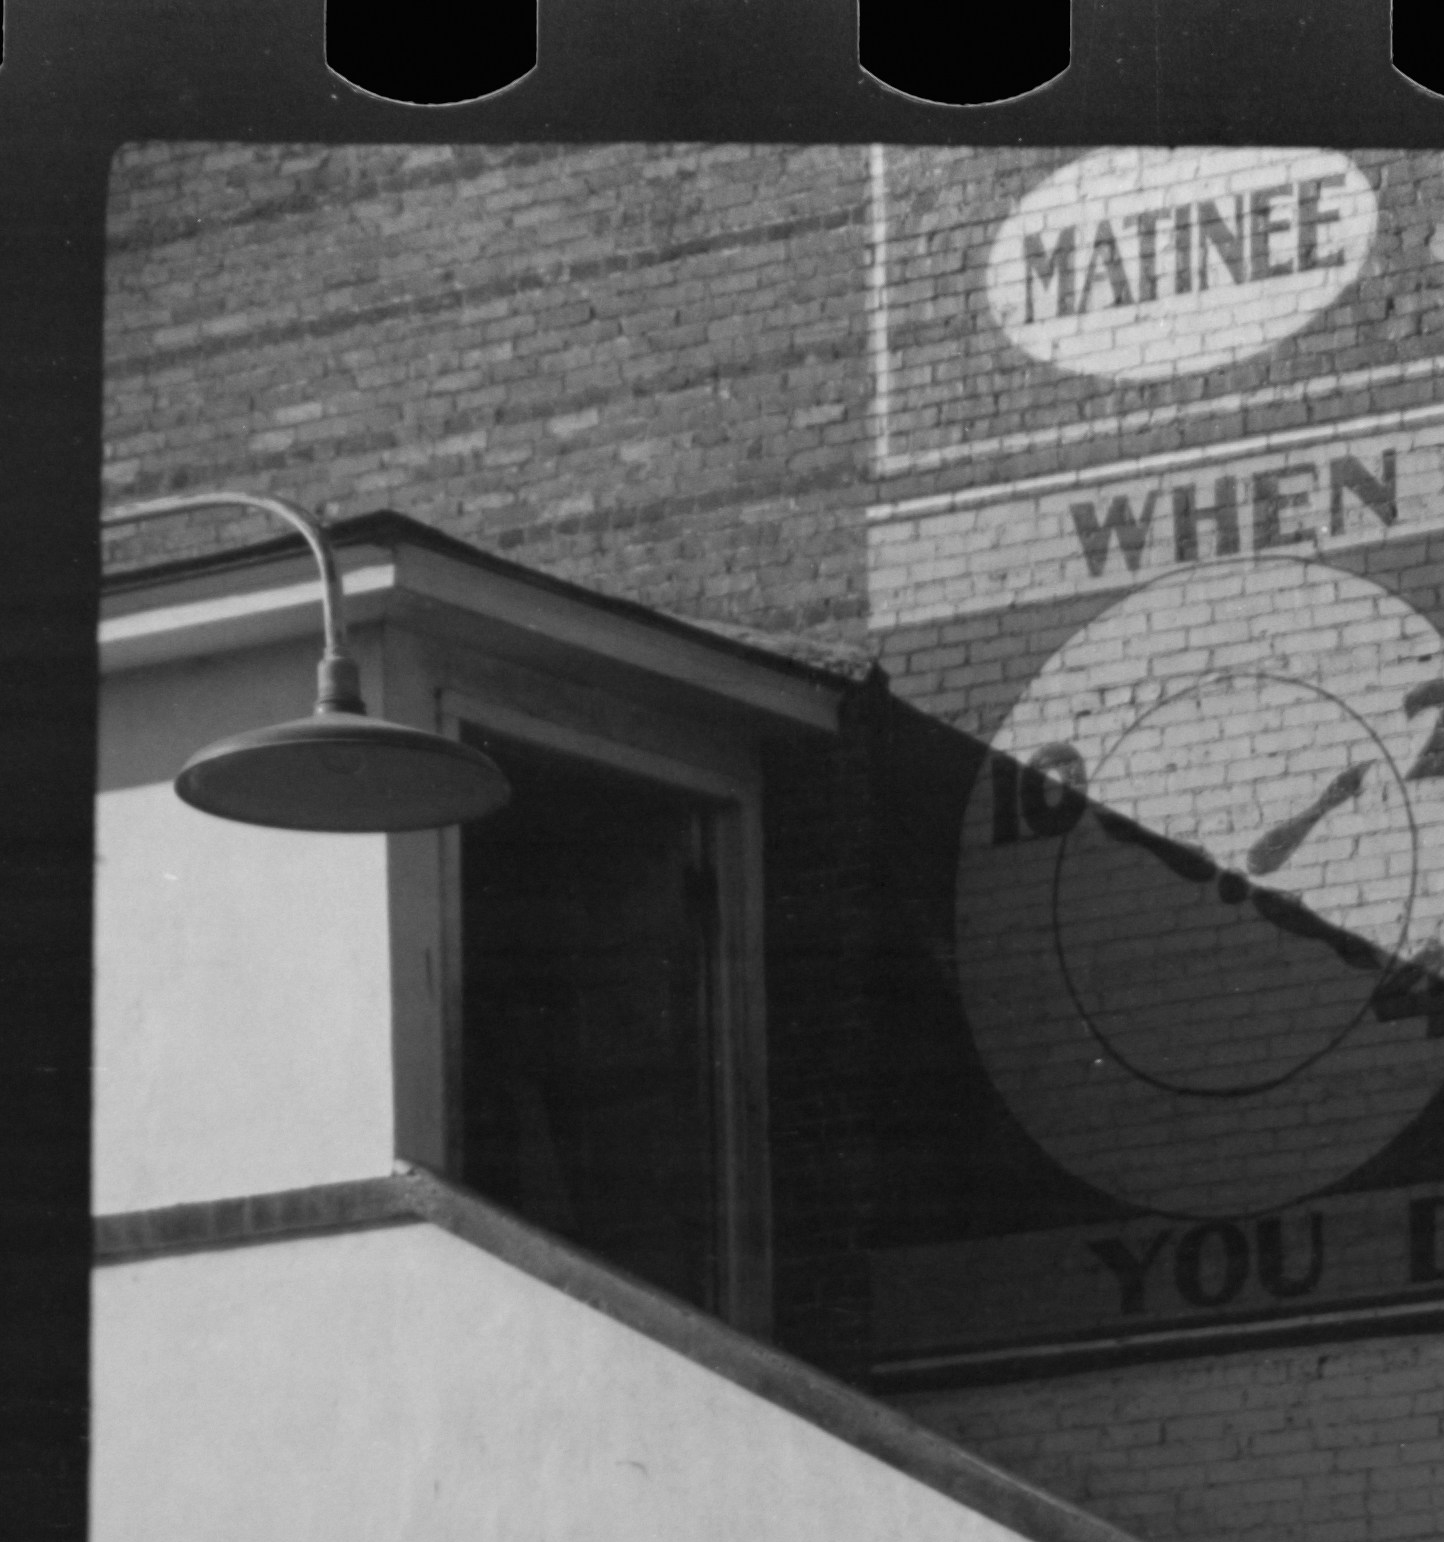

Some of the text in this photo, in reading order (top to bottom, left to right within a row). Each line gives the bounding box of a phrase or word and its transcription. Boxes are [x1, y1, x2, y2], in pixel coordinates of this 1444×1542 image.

[1022, 174, 1347, 323] MATINEE
[1069, 448, 1398, 577] WHEN
[991, 742, 1088, 845] 10
[1085, 1211, 1323, 1318] YOU
